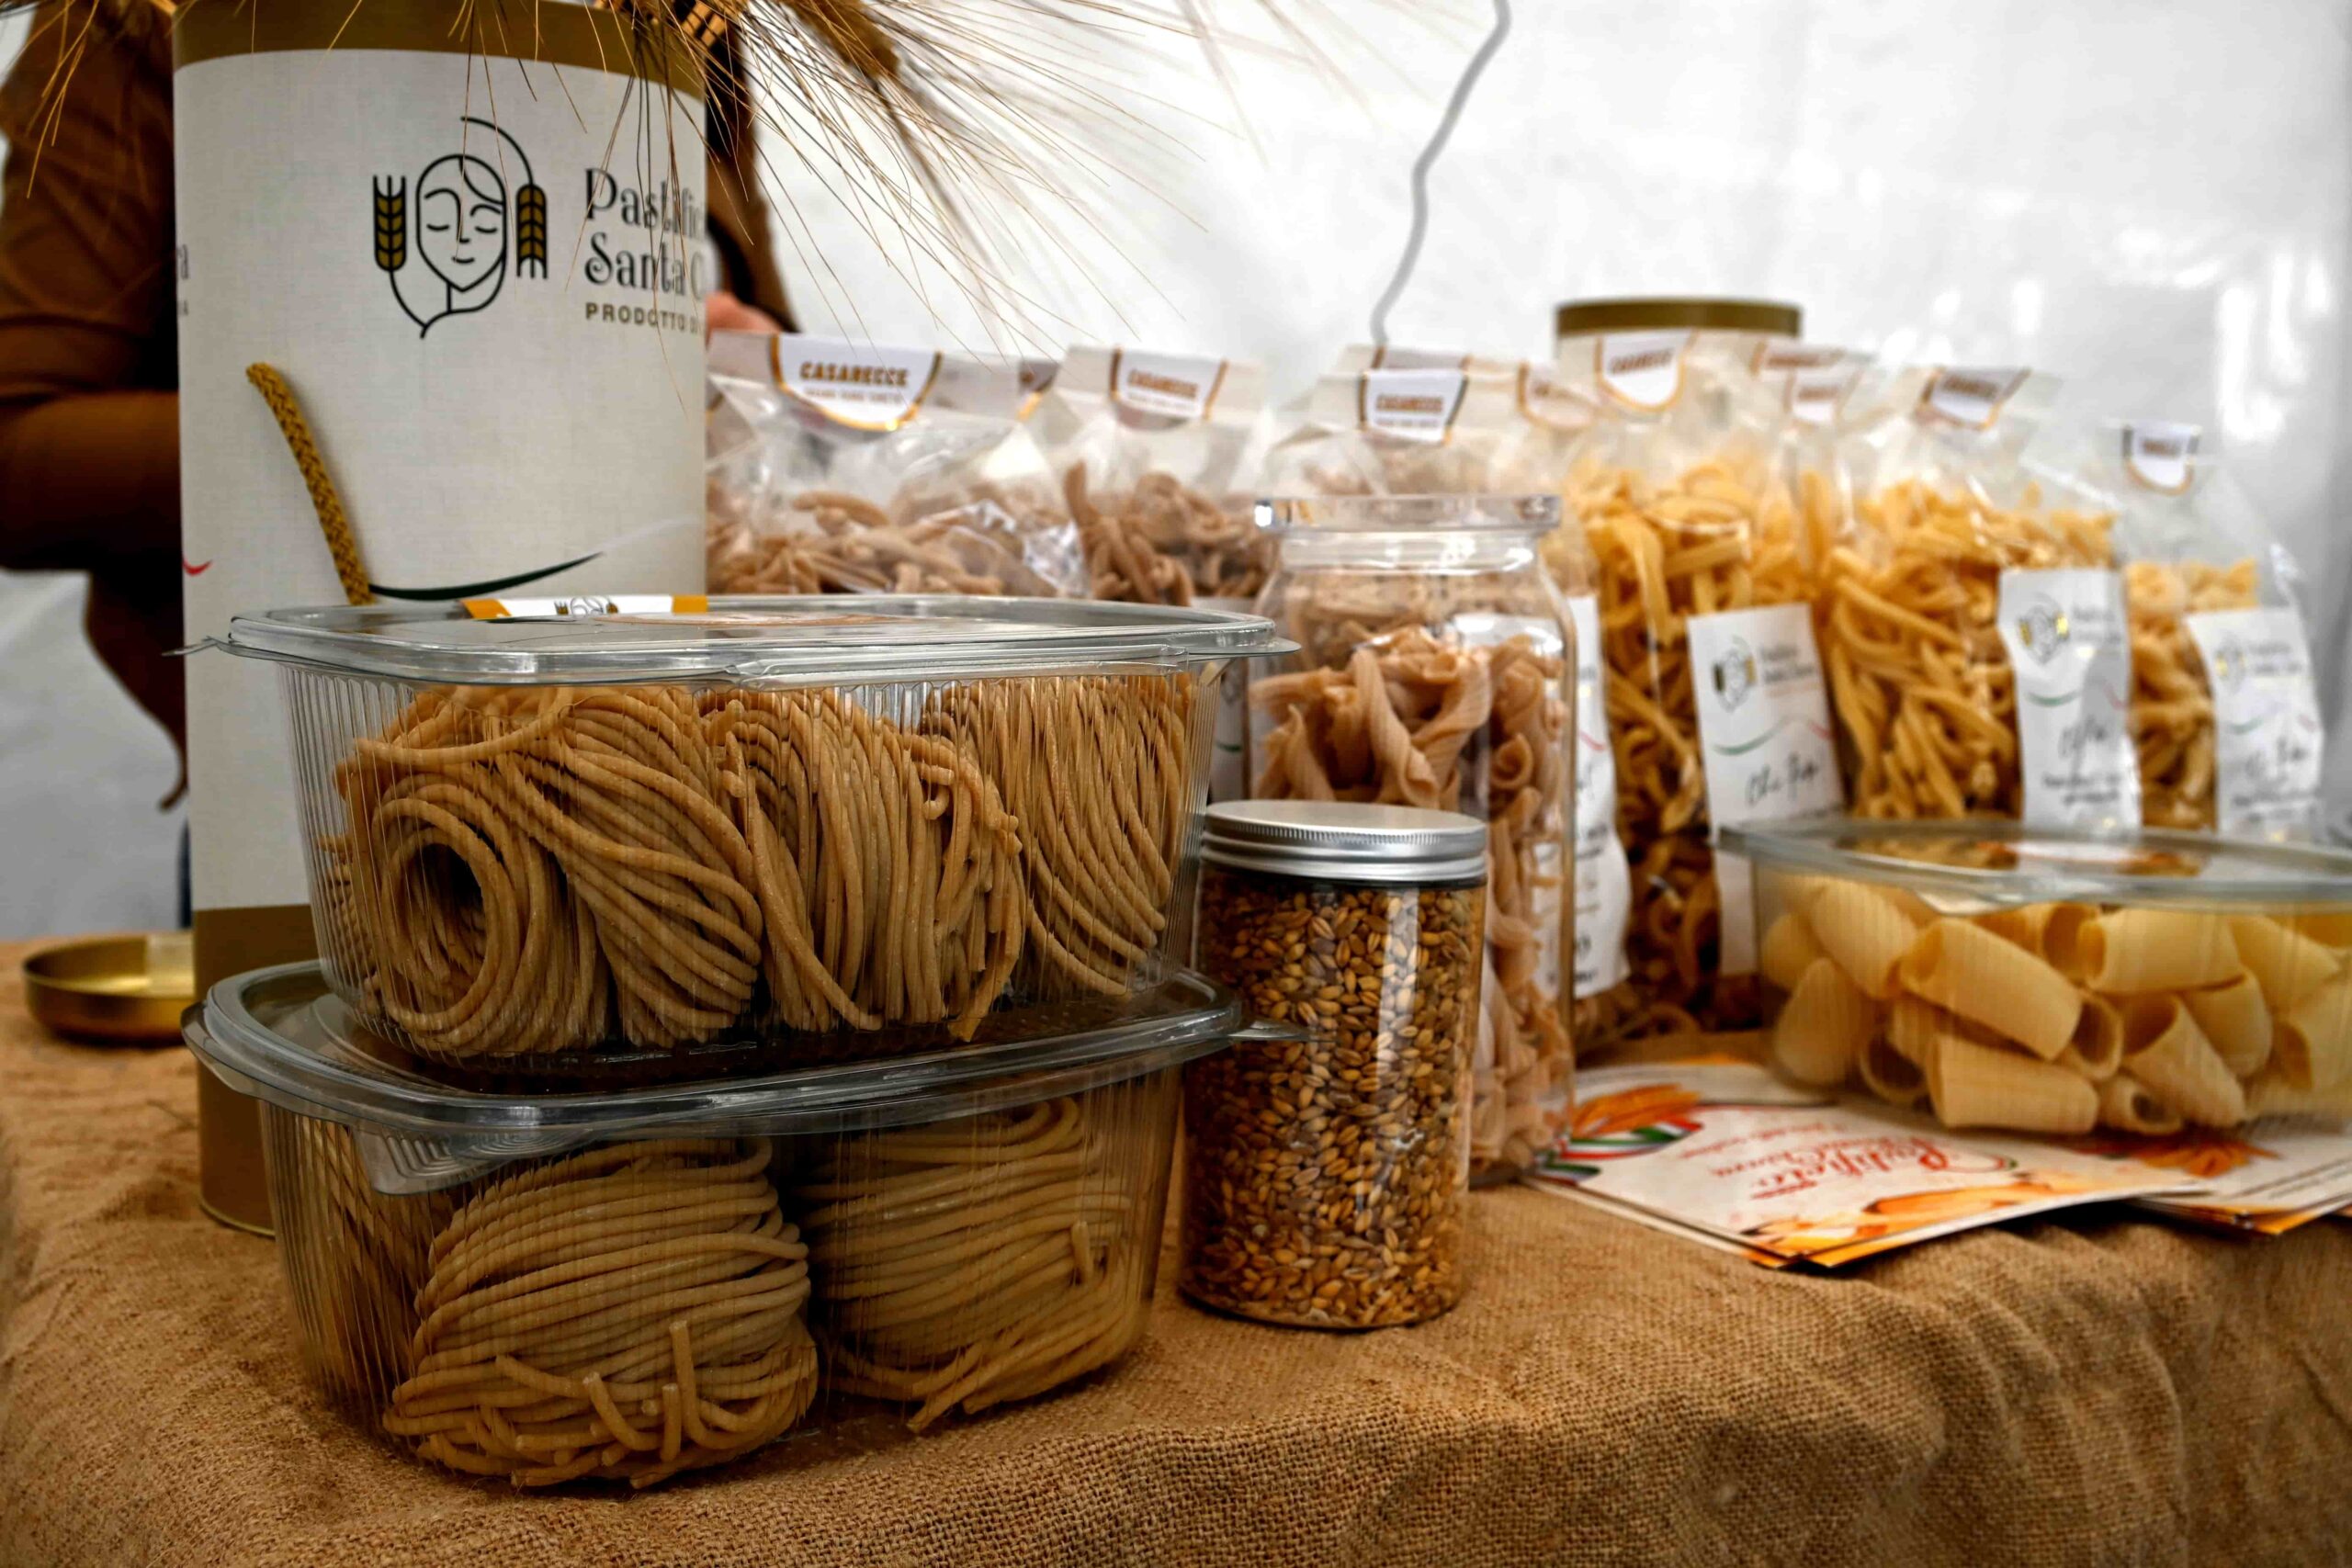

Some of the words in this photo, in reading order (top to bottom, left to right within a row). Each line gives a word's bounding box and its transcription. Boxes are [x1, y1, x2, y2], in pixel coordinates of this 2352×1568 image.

[583, 231, 686, 297] Santa
[585, 301, 685, 332] PRODOTTO
[799, 359, 909, 388] CASARECCE
